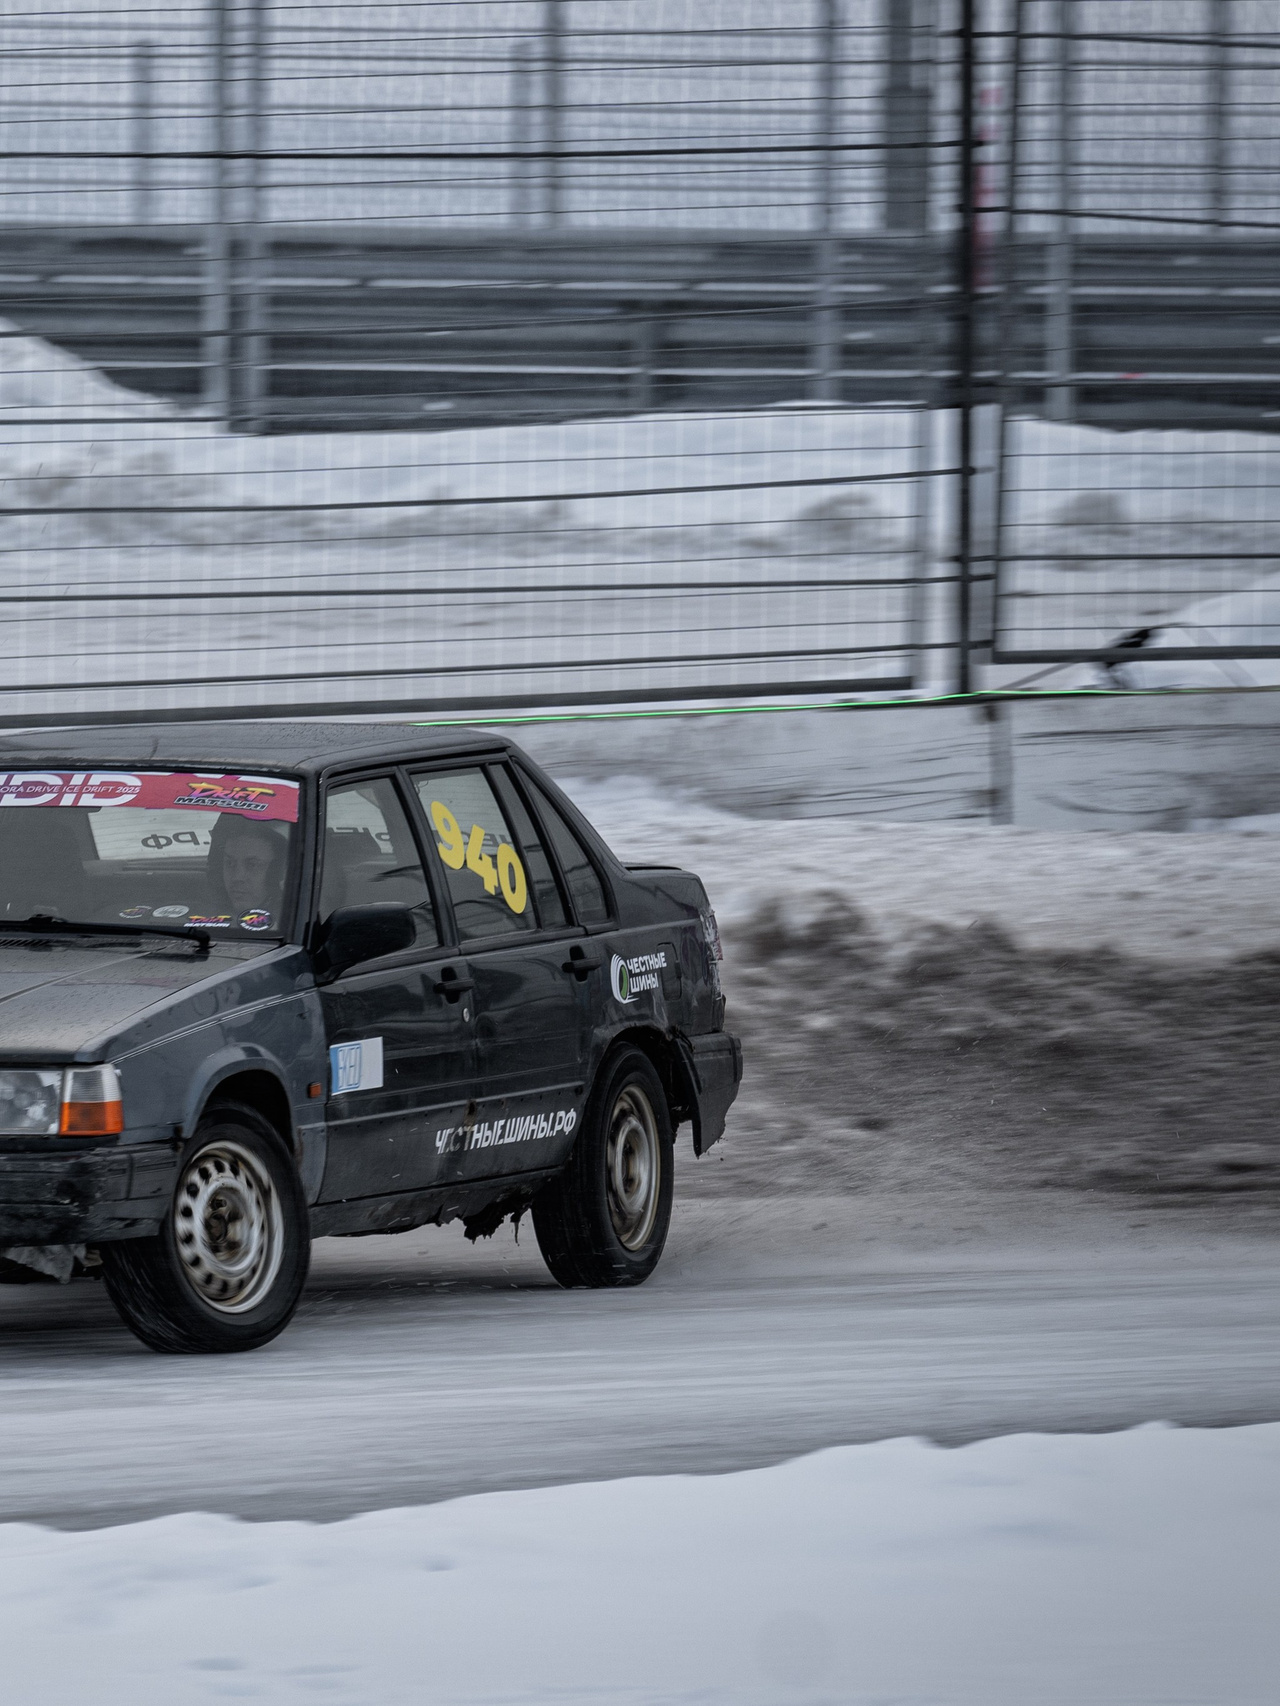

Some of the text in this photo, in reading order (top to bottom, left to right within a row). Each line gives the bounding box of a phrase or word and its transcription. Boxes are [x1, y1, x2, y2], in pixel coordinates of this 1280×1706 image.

[26, 785, 59, 793] DRIVE
[62, 785, 80, 793] ICE
[82, 785, 115, 793] DRIFT
[115, 786, 142, 794] 2025
[173, 796, 269, 811] MATSURI
[430, 801, 527, 914] 940
[626, 952, 667, 974] ЧЕСТНЫЕ
[630, 972, 659, 993] ШИНЫ
